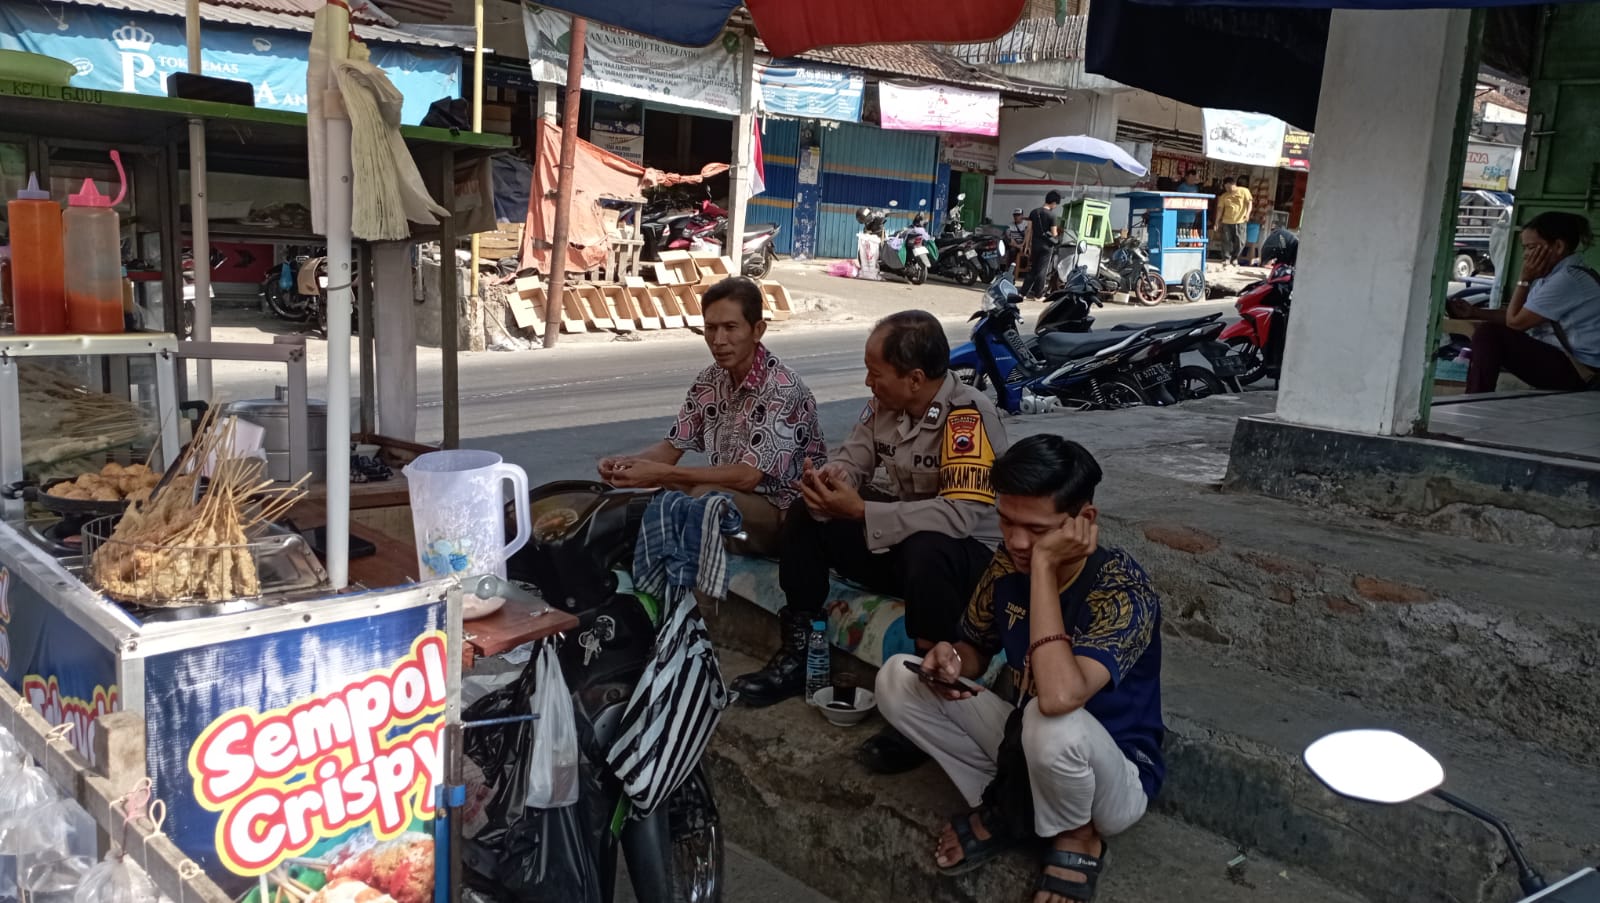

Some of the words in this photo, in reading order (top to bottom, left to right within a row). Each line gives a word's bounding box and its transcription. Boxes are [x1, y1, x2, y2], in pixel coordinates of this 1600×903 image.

[157, 55, 188, 69] TOK
[203, 61, 239, 74] EMAS
[198, 638, 447, 800] Sempol
[223, 722, 446, 870] Crispy
